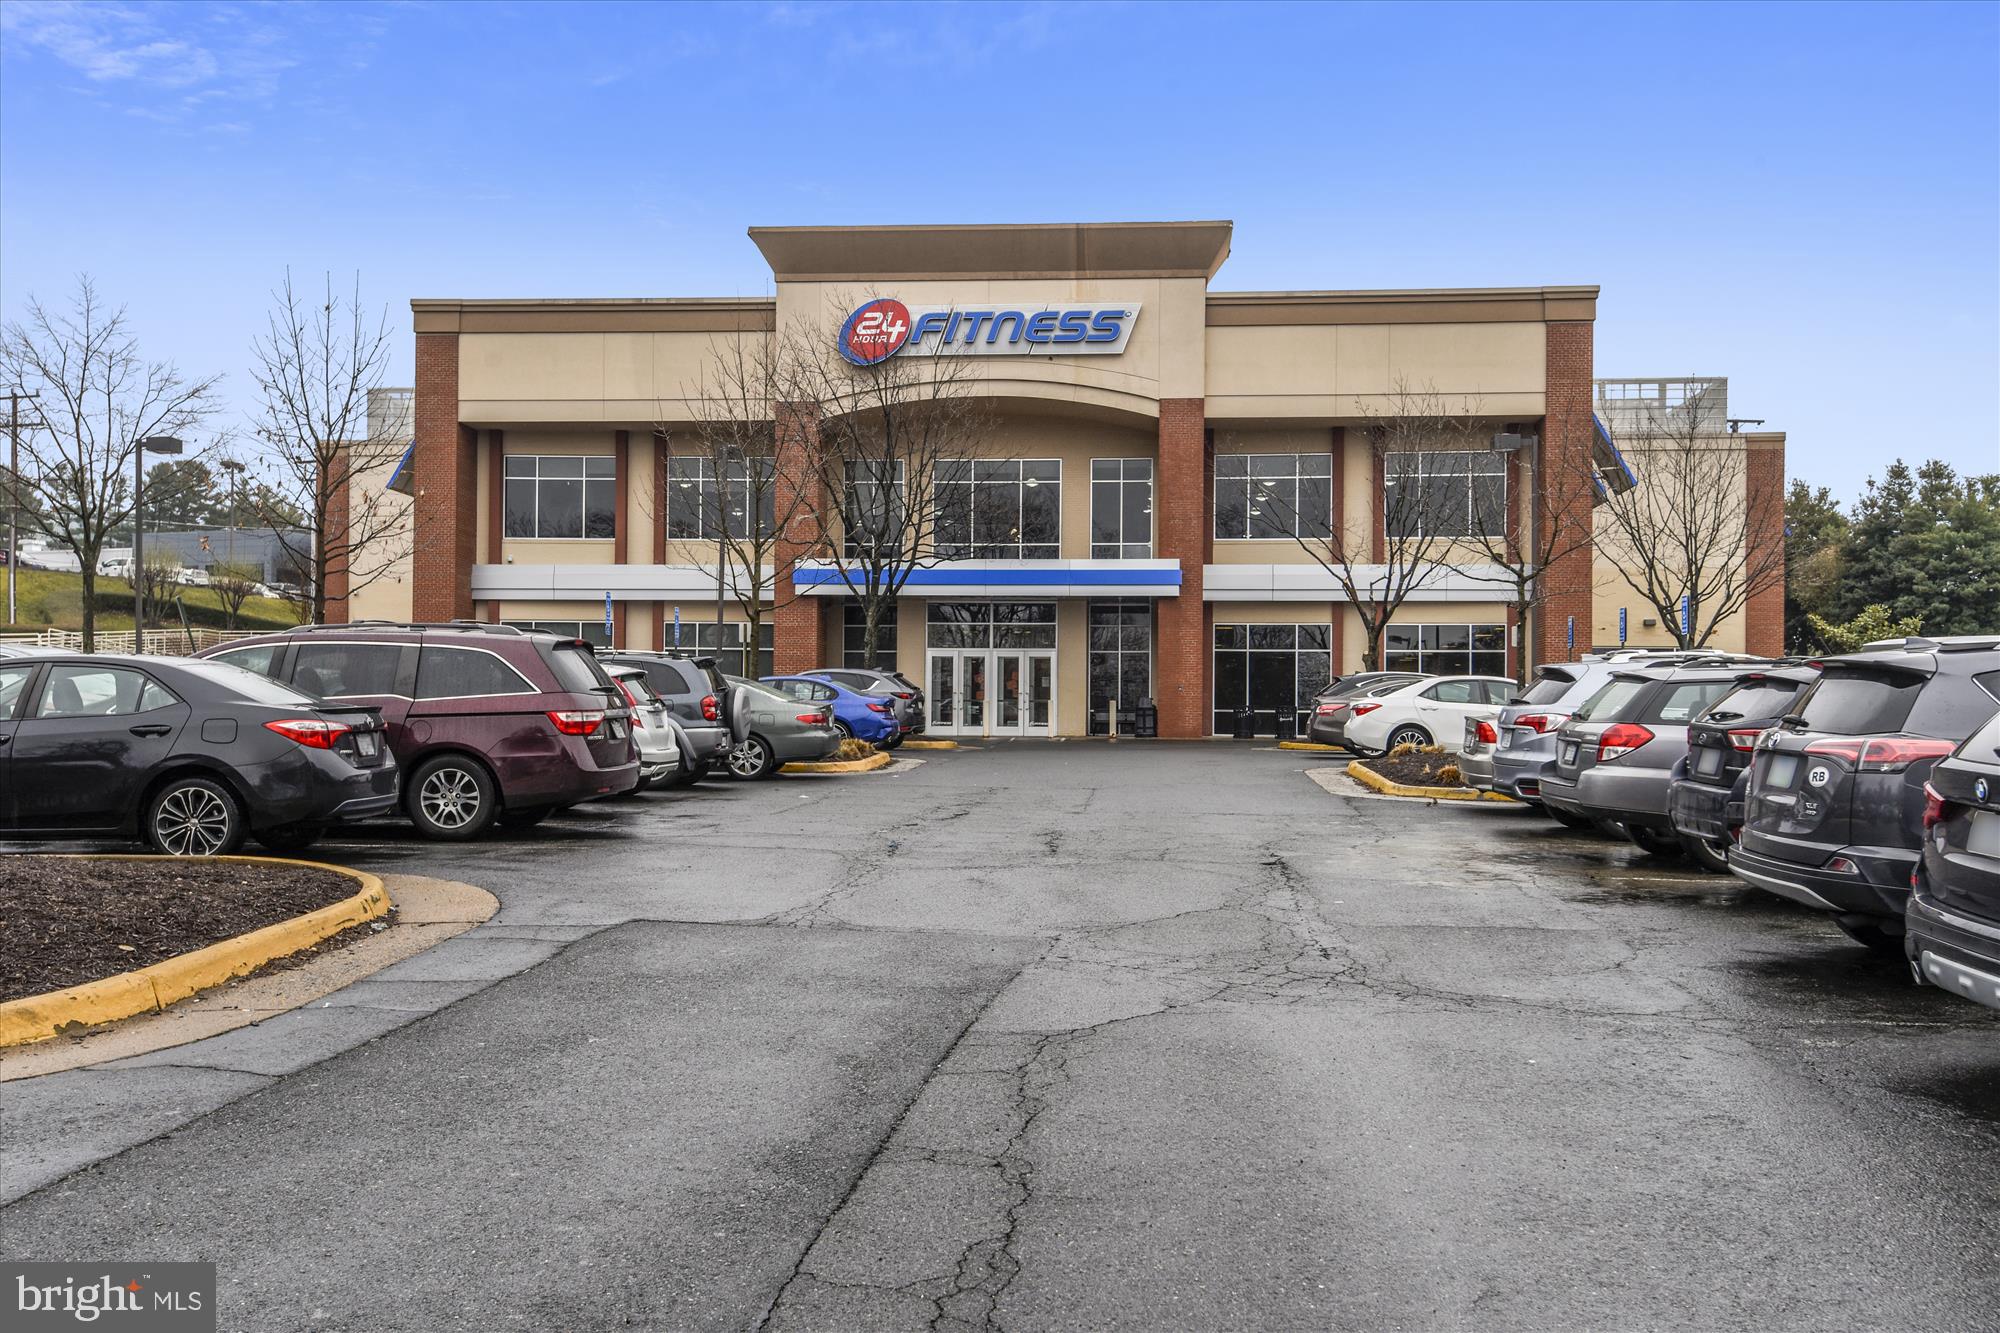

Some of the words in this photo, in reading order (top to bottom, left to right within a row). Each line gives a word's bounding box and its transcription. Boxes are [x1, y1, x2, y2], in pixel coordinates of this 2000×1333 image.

[856, 311, 907, 343] 24
[910, 310, 1126, 344] FITNESS
[852, 335, 888, 343] HOUR
[1812, 771, 1826, 782] RB
